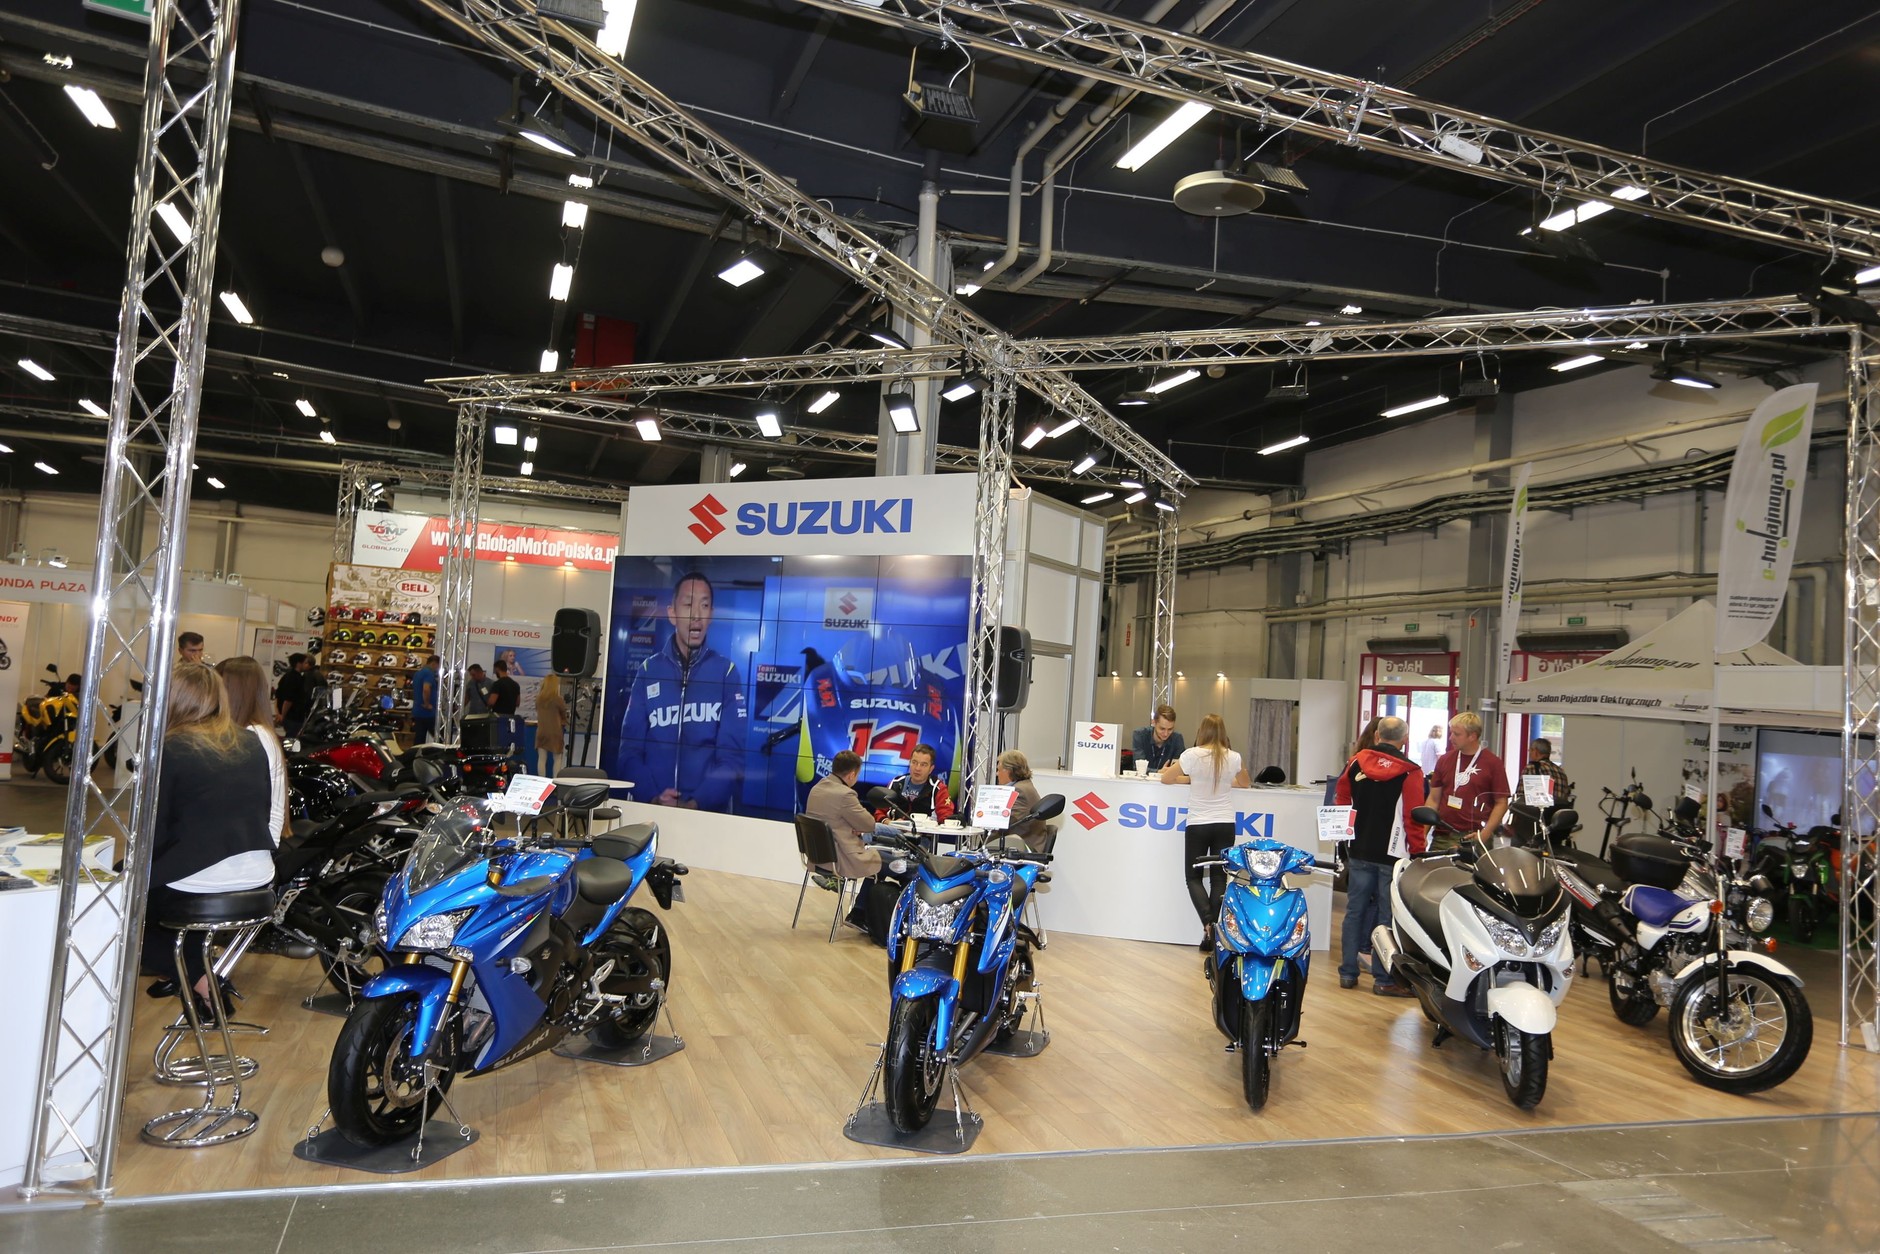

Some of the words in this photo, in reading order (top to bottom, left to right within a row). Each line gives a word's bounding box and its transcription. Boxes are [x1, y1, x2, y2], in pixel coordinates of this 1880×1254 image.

[736, 498, 913, 536] SUZUKI
[0, 577, 35, 590] NDA
[40, 580, 87, 593] PLAZA
[401, 582, 430, 593] BELL
[824, 617, 870, 629] SUZUKI
[458, 626, 487, 635] UIOR
[489, 628, 510, 637] BIKE
[513, 629, 541, 639] TOOLS
[757, 672, 802, 684] SUZUKI
[850, 697, 917, 715] SUZUKI
[1537, 694, 1559, 703] Salon
[1600, 694, 1662, 708] Elektrycznych
[849, 718, 922, 762] 14
[1076, 740, 1114, 750] SUZUKI
[493, 1028, 550, 1070] SUZUKI
